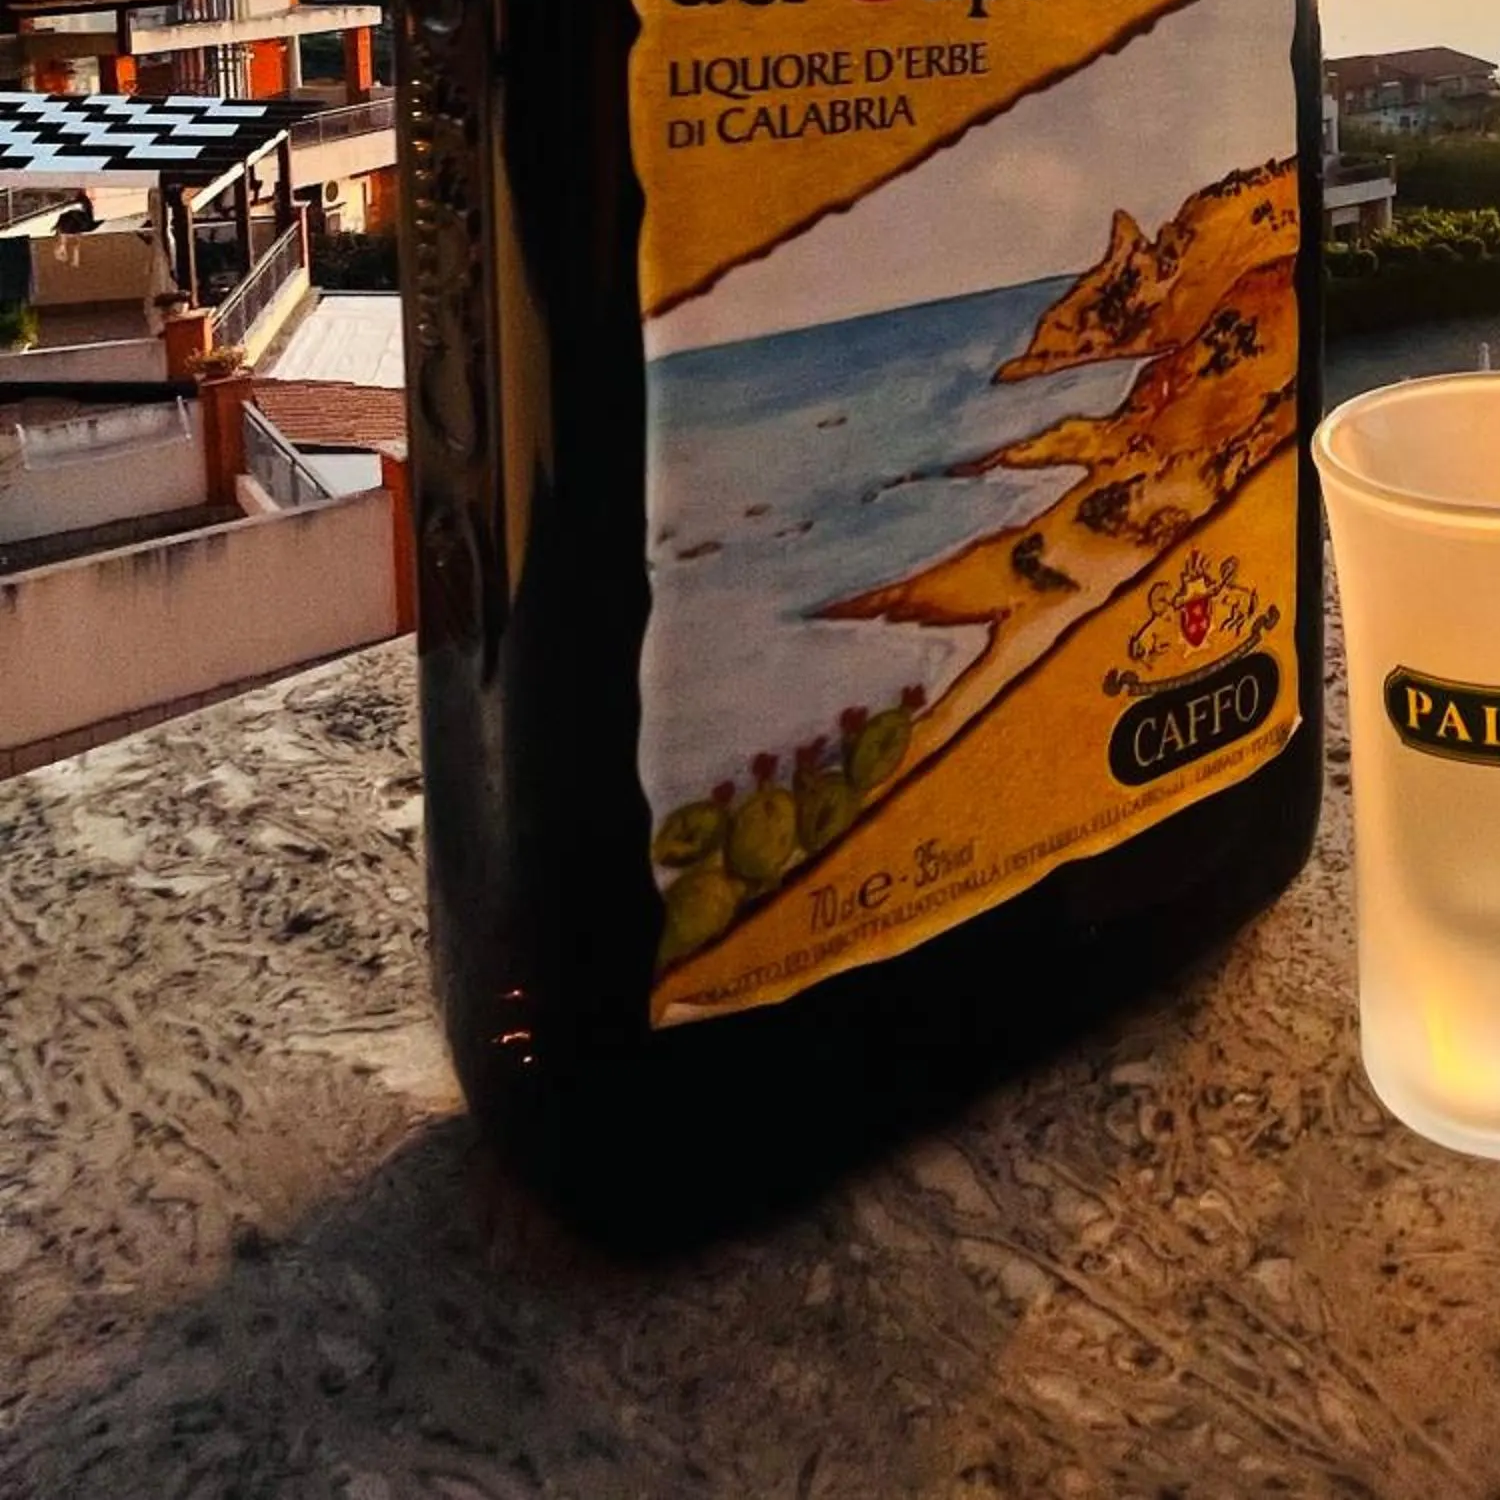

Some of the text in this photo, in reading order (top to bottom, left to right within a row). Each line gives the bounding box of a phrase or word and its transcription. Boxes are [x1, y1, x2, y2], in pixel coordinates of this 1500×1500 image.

[669, 42, 991, 100] LIQUORE D'ERBE
[668, 94, 917, 149] DI CALABRIA
[1134, 674, 1260, 768] CAFFO
